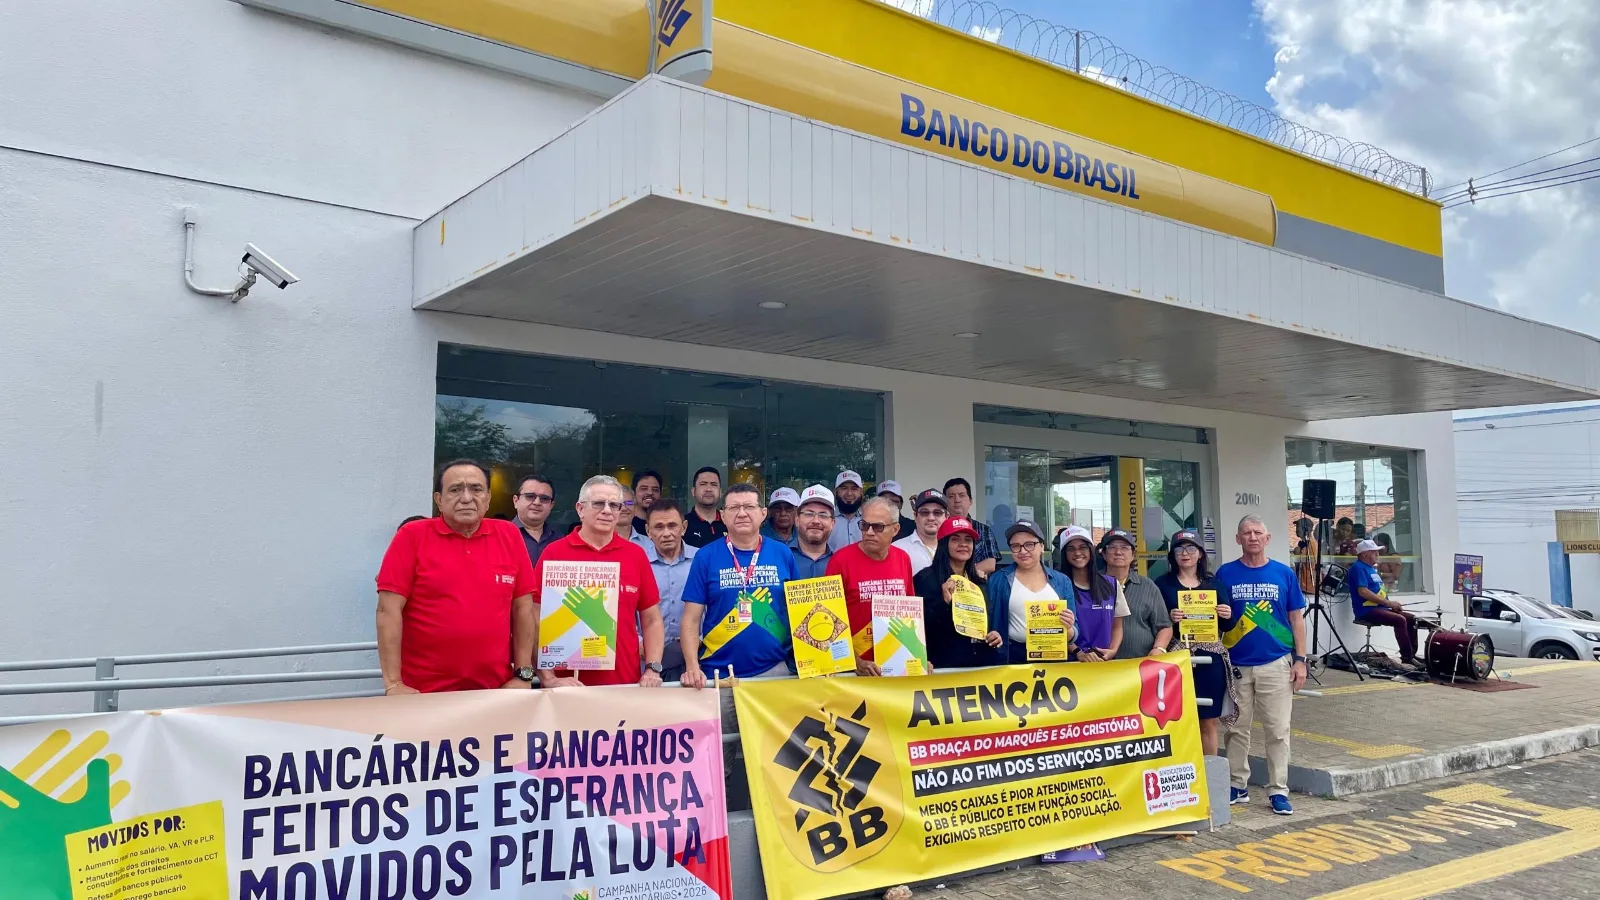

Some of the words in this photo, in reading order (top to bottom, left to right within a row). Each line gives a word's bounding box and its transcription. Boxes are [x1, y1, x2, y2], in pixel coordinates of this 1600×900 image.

[901, 92, 1008, 162] BANCO
[1012, 133, 1050, 174] DO
[1052, 140, 1140, 200] BRASIL
[1235, 492, 1261, 506] 2000
[545, 579, 577, 587] MOVIDOS
[579, 580, 595, 588] PELA
[570, 572, 578, 580] DE
[907, 669, 1079, 728] ATENÇÃO
[910, 745, 928, 760] BB
[930, 740, 971, 758] PRAÇA
[973, 737, 993, 750] DO
[994, 728, 1049, 749] MARQUÊS
[1050, 729, 1057, 739] E
[1060, 724, 1080, 738] SÃO
[1082, 718, 1139, 736] CRISTÓVÃO
[243, 733, 480, 800] BANCÁRIAS
[493, 734, 514, 774] E
[526, 720, 695, 771] BANCÁRIOS
[913, 768, 948, 791] NÃO
[951, 767, 974, 785] AO
[977, 762, 1003, 780] FIM
[1005, 757, 1035, 776] DOS
[1037, 748, 1102, 772] SERVIÇOS
[1105, 746, 1124, 759] DE
[1126, 738, 1166, 756] CAIXA!
[1159, 767, 1182, 776] SINDICATO
[1183, 765, 1194, 773] DOS
[1160, 772, 1195, 784] BANCÁRIOS
[919, 800, 958, 818] MENOS
[960, 794, 999, 811] CAIXAS
[1001, 790, 1008, 803] É
[1010, 787, 1034, 801] PIOR
[1036, 775, 1106, 797] ATENDIMENTO.
[1161, 785, 1171, 793] DO
[1172, 781, 1188, 791] PIAUÍ
[242, 793, 409, 860] FEITOS
[425, 785, 479, 836] DE
[494, 771, 704, 827] ESPERANÇA
[924, 821, 933, 832] O
[935, 817, 949, 830] BB
[951, 814, 958, 827] É
[960, 806, 1005, 826] PÚBLICO
[1007, 806, 1013, 816] E
[1015, 802, 1036, 815] TEM
[1039, 793, 1078, 812] FUNÇÃO
[924, 827, 977, 848] EXIGIMOS
[979, 819, 1026, 838] RESPEITO
[1028, 814, 1050, 827] COM
[1053, 812, 1061, 822] A
[1062, 800, 1122, 821] POPULAÇÃO.
[85, 858, 119, 871] Aumento
[182, 839, 193, 847] VR
[200, 835, 215, 843] PLR
[87, 821, 150, 853] MOVIDOS
[154, 815, 186, 835] POR:
[806, 806, 888, 866] BB
[86, 873, 130, 891] conquistados
[137, 858, 193, 876] fortalecimento
[204, 852, 219, 861] CCT
[140, 856, 169, 867] direitos
[240, 840, 472, 900] MOVIDOS
[489, 827, 595, 890] PELA
[608, 817, 707, 875] LUTA
[122, 880, 150, 891] bancos
[150, 873, 183, 888] públicos
[154, 884, 187, 897] bancário
[598, 882, 650, 898] CAMPANHA
[650, 876, 701, 890] NACIONAL
[684, 886, 707, 898] 2026
